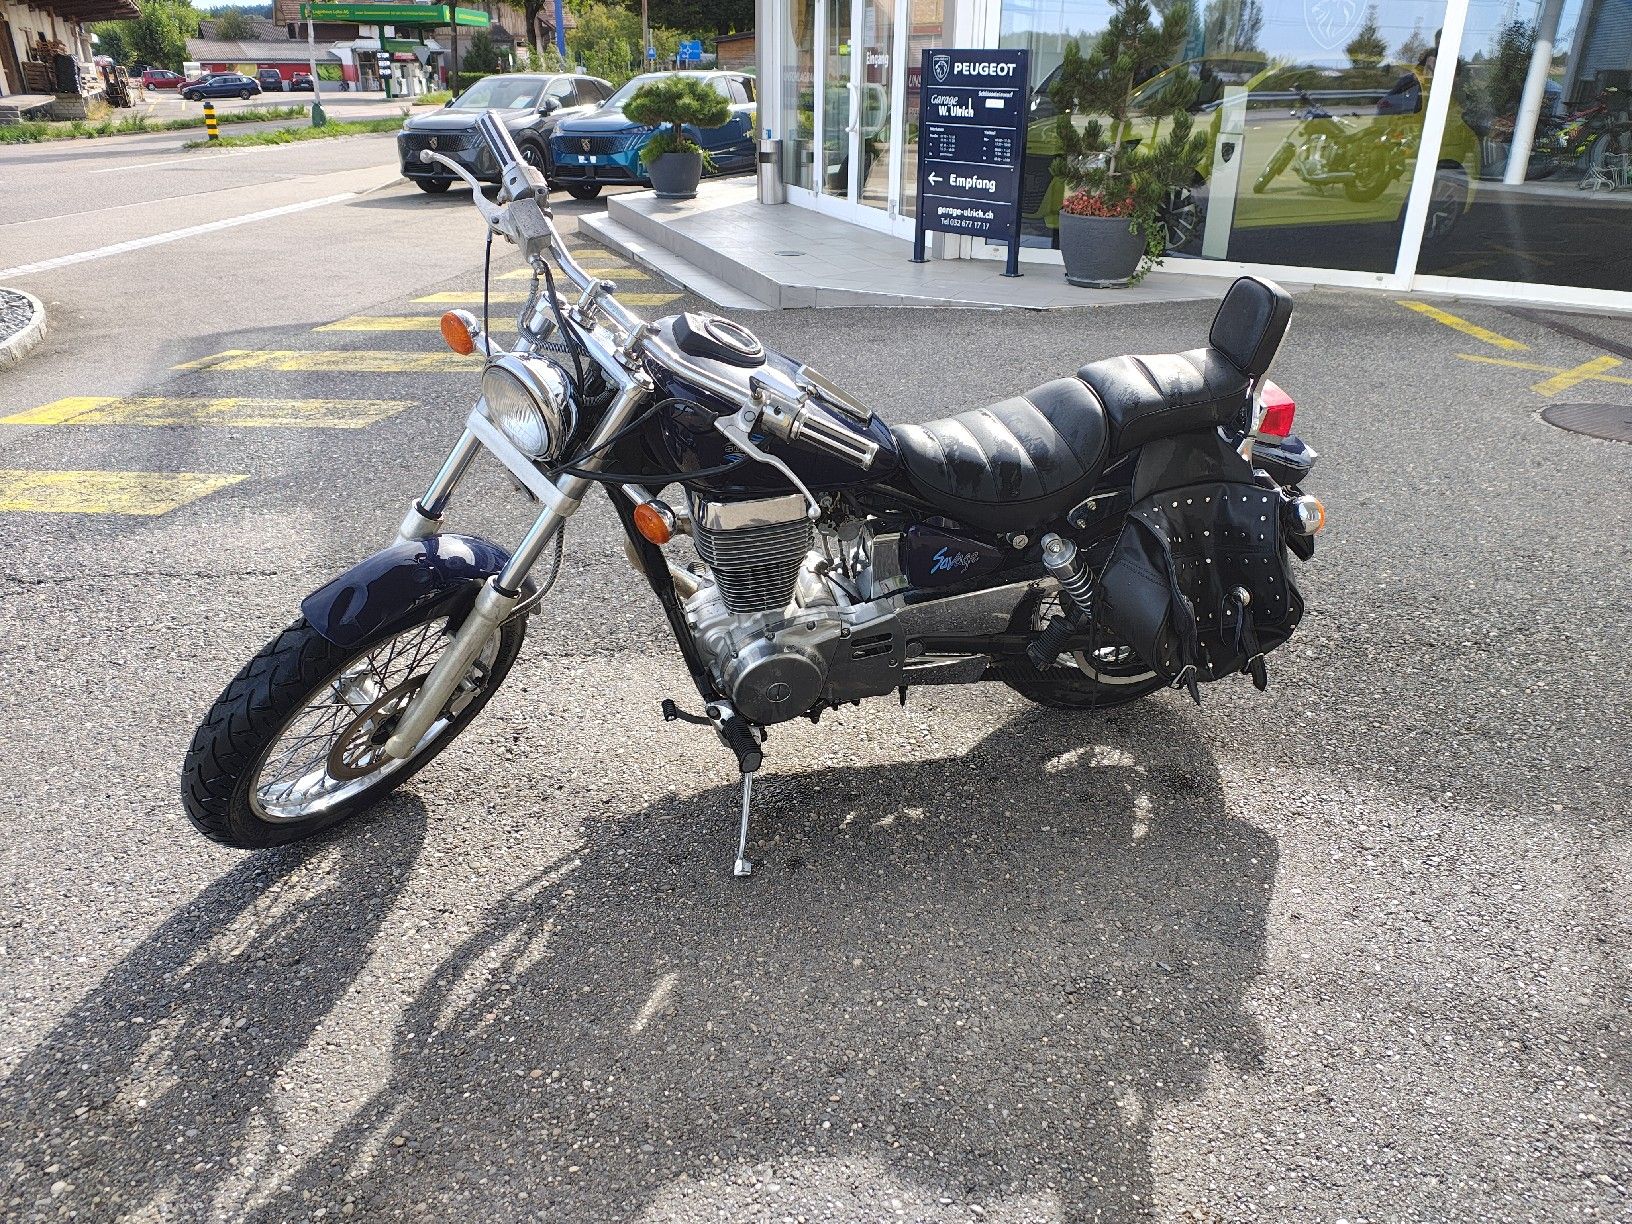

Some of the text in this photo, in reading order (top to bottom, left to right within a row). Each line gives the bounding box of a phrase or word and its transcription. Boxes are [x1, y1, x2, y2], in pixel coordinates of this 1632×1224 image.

[866, 50, 889, 67] Eingang
[954, 62, 1016, 76] PEUGEOT
[931, 94, 958, 107] Garage
[938, 98, 974, 117] W. Ulrich
[949, 174, 996, 192] Empfang
[937, 207, 993, 219] garage-ulrich.ch
[950, 218, 960, 227] 032
[961, 220, 973, 228] 677
[974, 221, 981, 229] 17
[982, 222, 990, 230] 17
[931, 547, 979, 574] Savage
